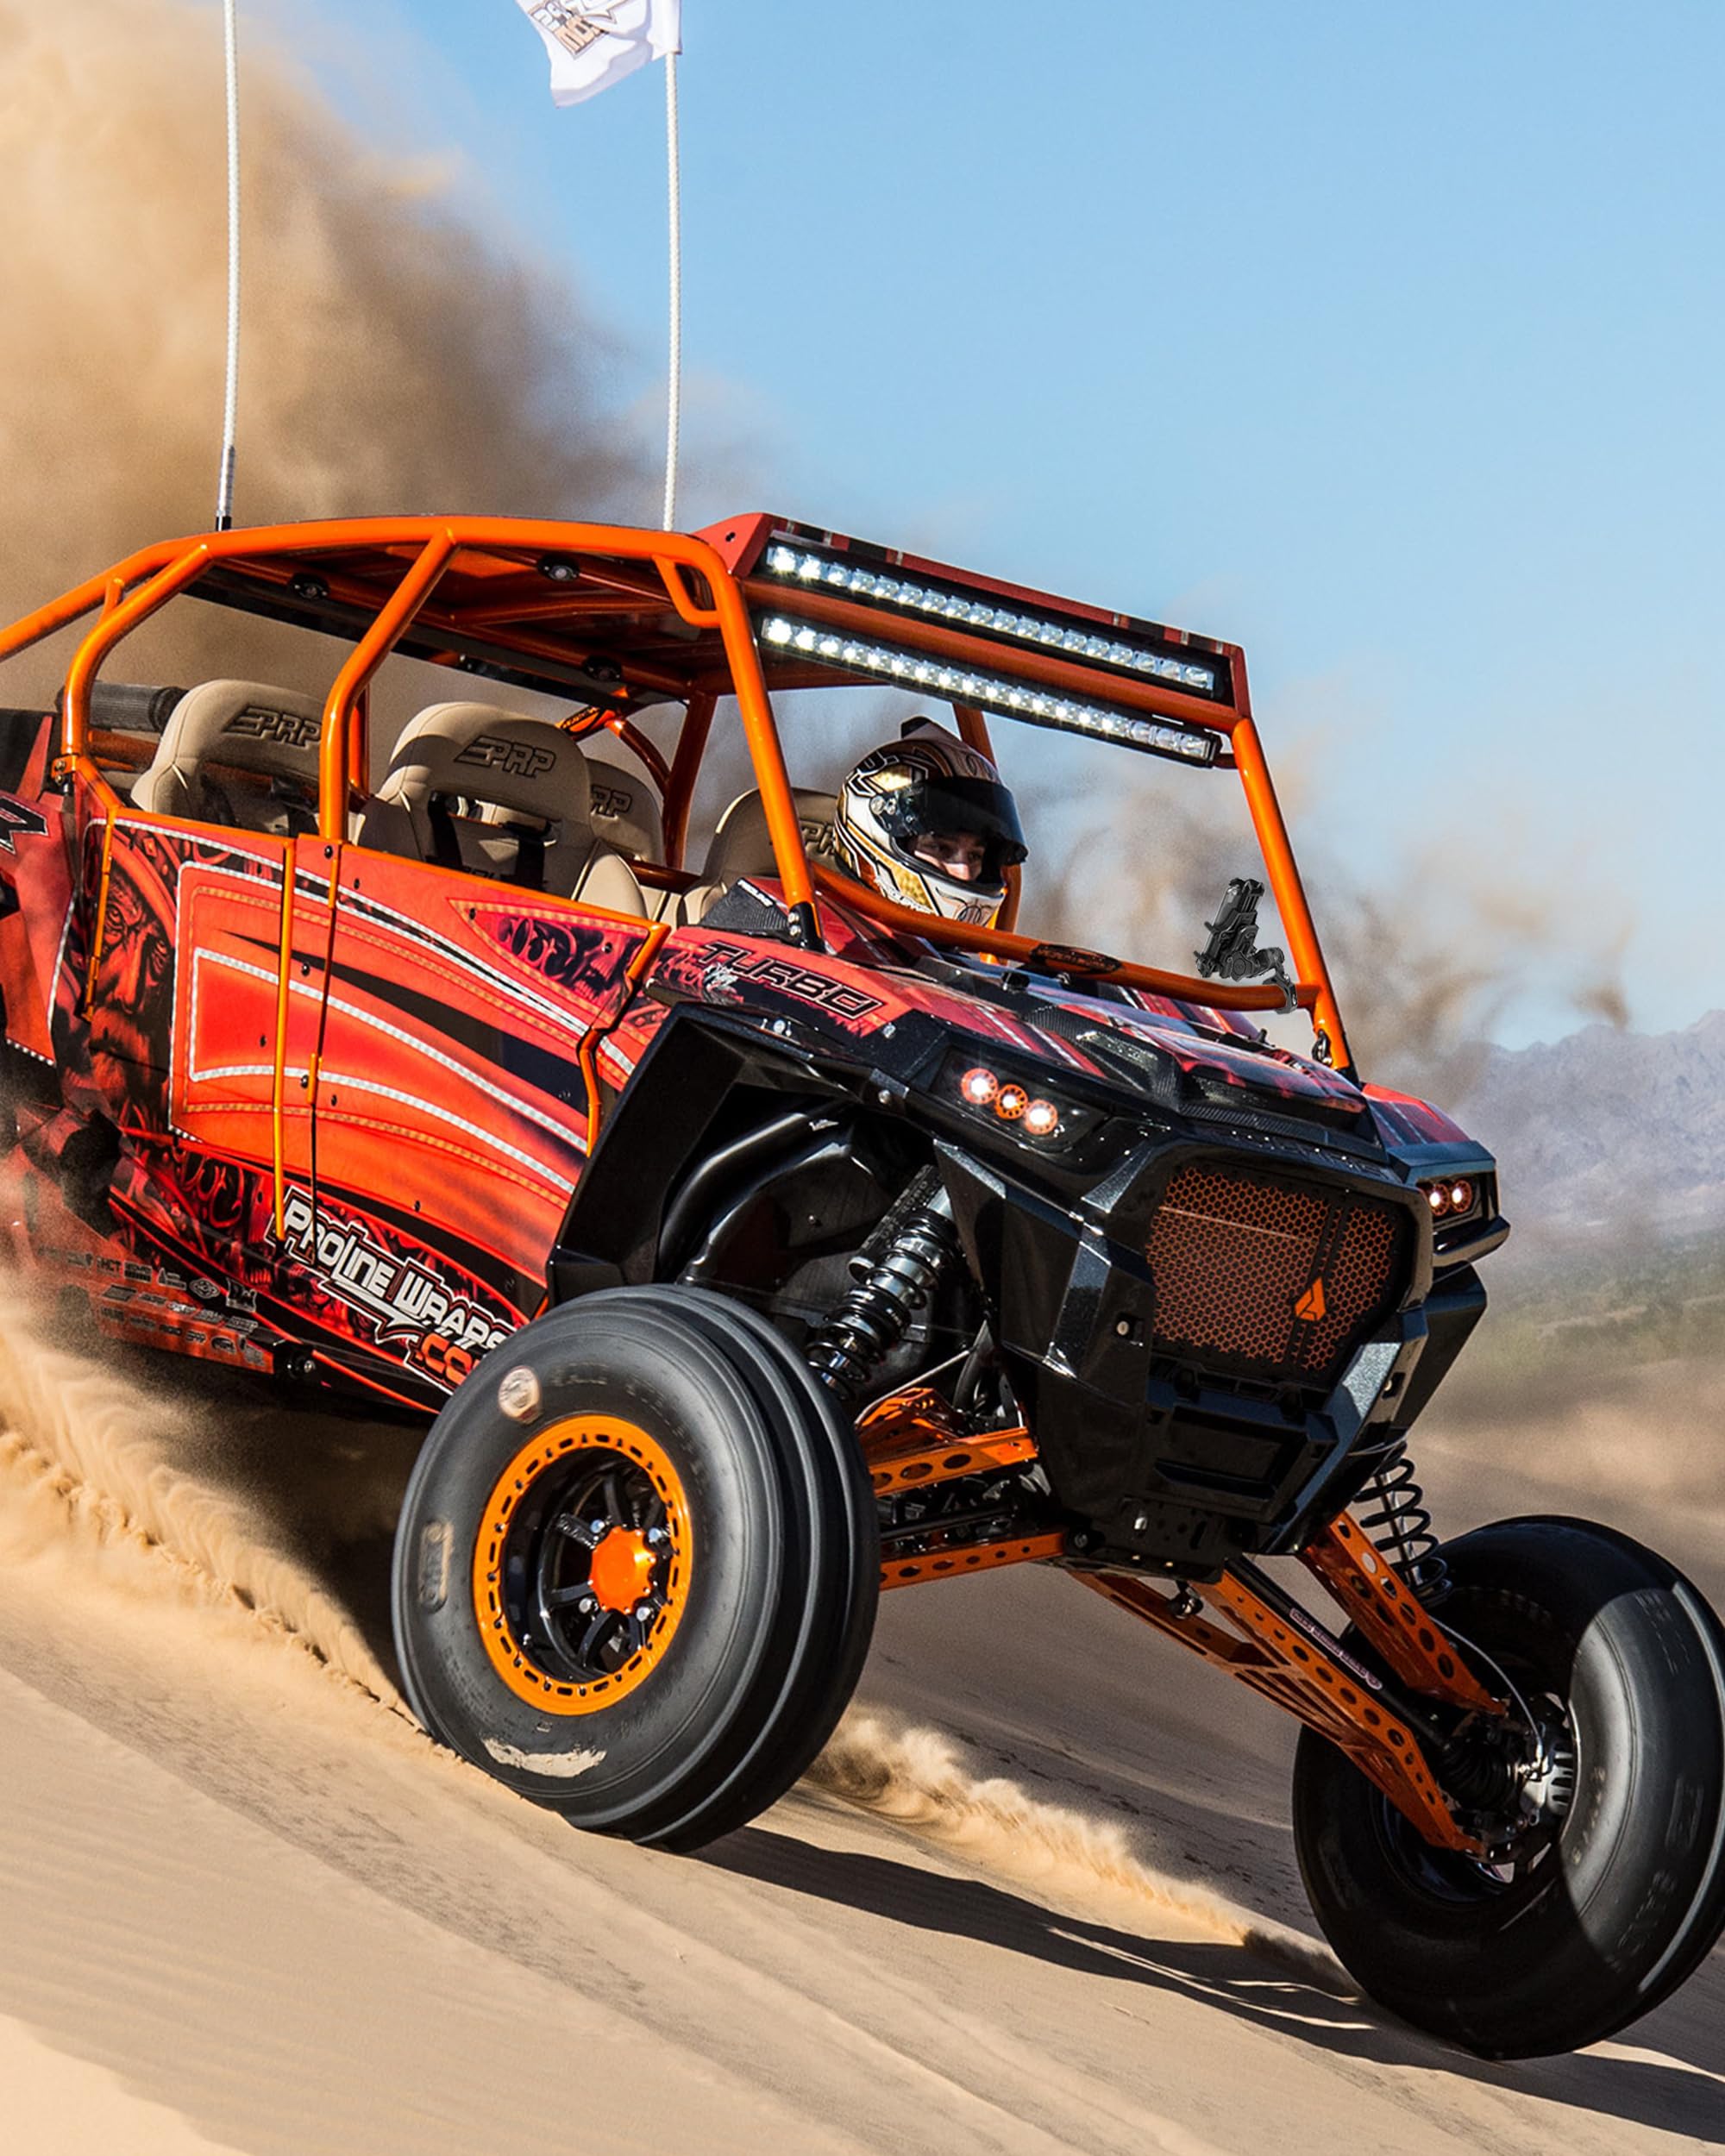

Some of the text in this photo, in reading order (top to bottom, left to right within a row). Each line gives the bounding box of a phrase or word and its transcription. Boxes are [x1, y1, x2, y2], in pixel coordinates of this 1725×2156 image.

[455, 735, 557, 779] PRP
[592, 784, 632, 818] RP
[697, 938, 886, 1020] TURBO
